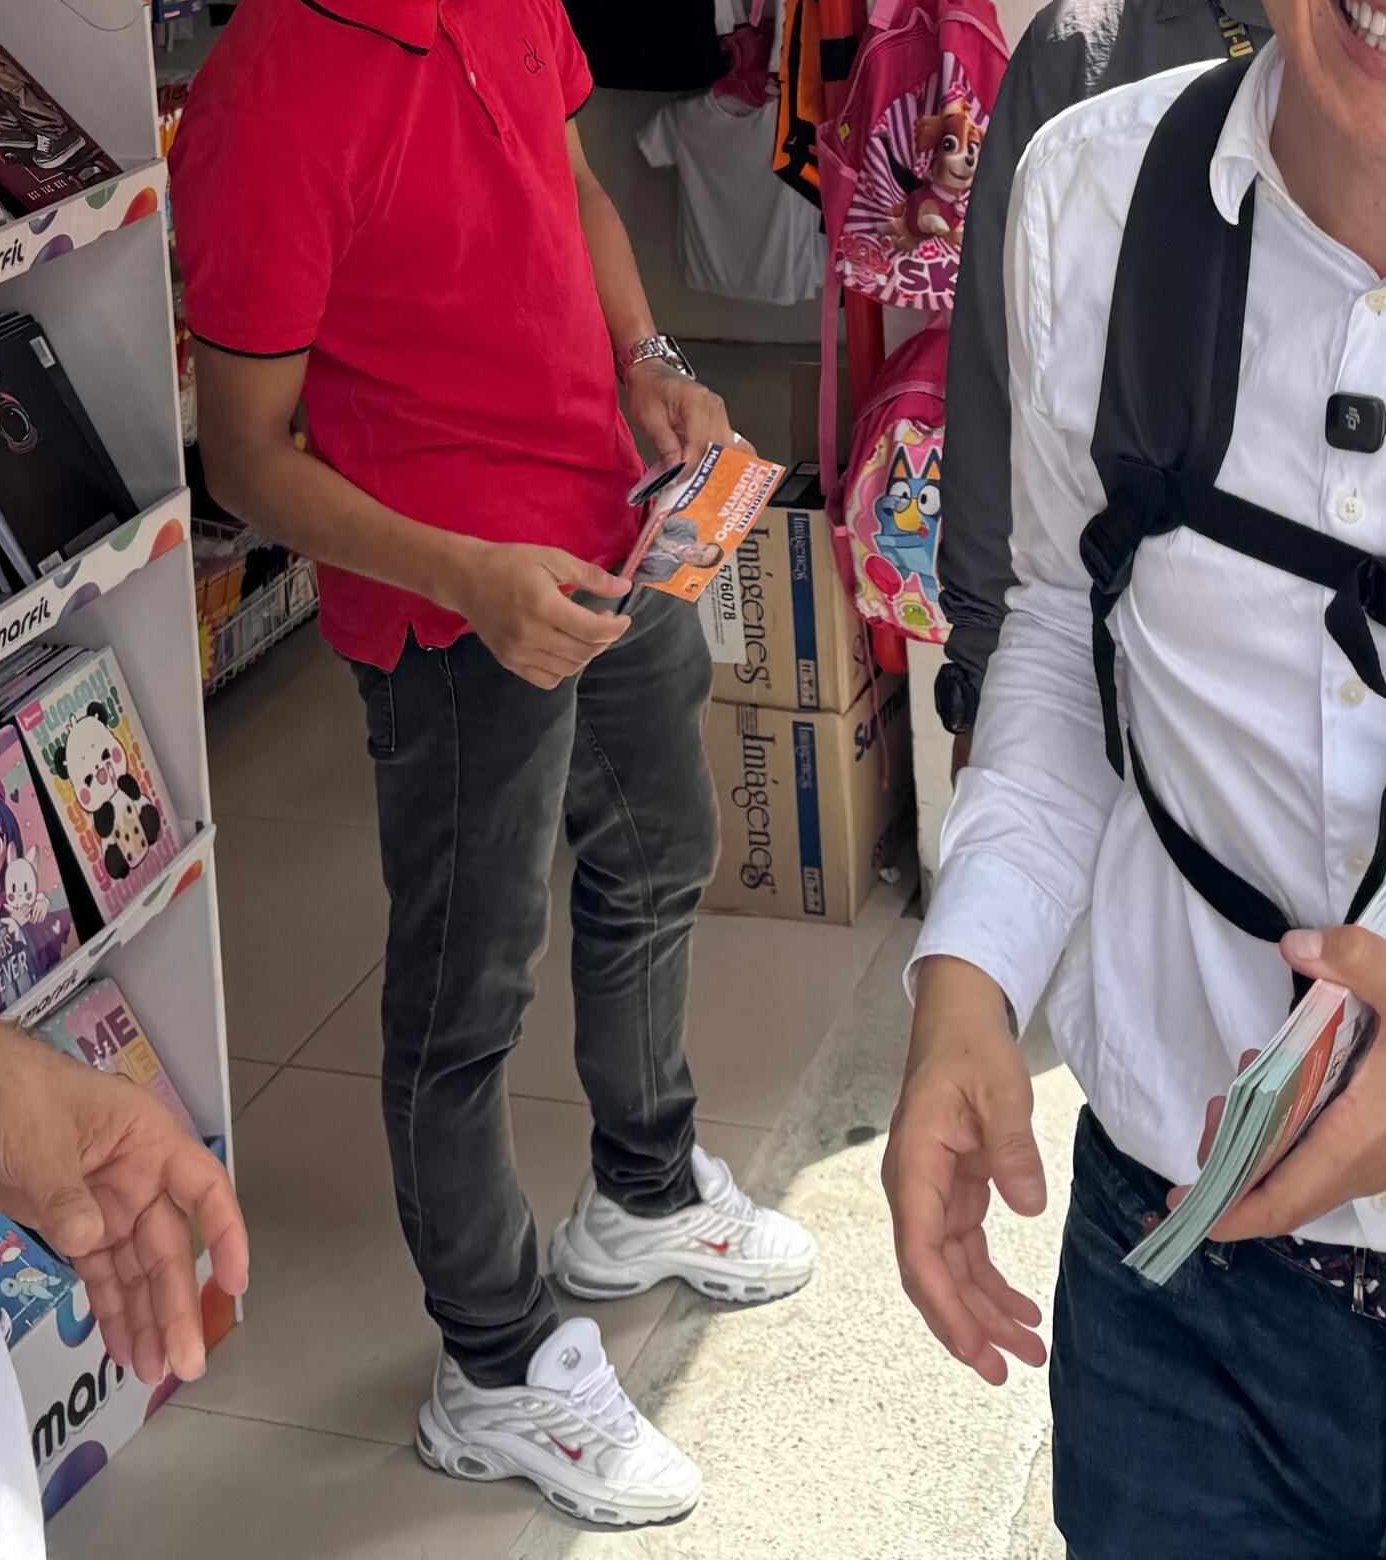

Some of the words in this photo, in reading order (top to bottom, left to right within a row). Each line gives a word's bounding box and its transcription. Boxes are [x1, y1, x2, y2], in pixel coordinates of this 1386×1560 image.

[896, 257, 960, 293] SK
[694, 475, 705, 488] de
[700, 449, 719, 474] Hoja
[717, 461, 759, 518] HUERTA
[715, 465, 770, 542] LEONARDO
[738, 470, 778, 532] PRESIDENTE
[734, 527, 774, 686] Imágenes
[33, 658, 112, 746] yummy!
[731, 729, 779, 890] Imágenes
